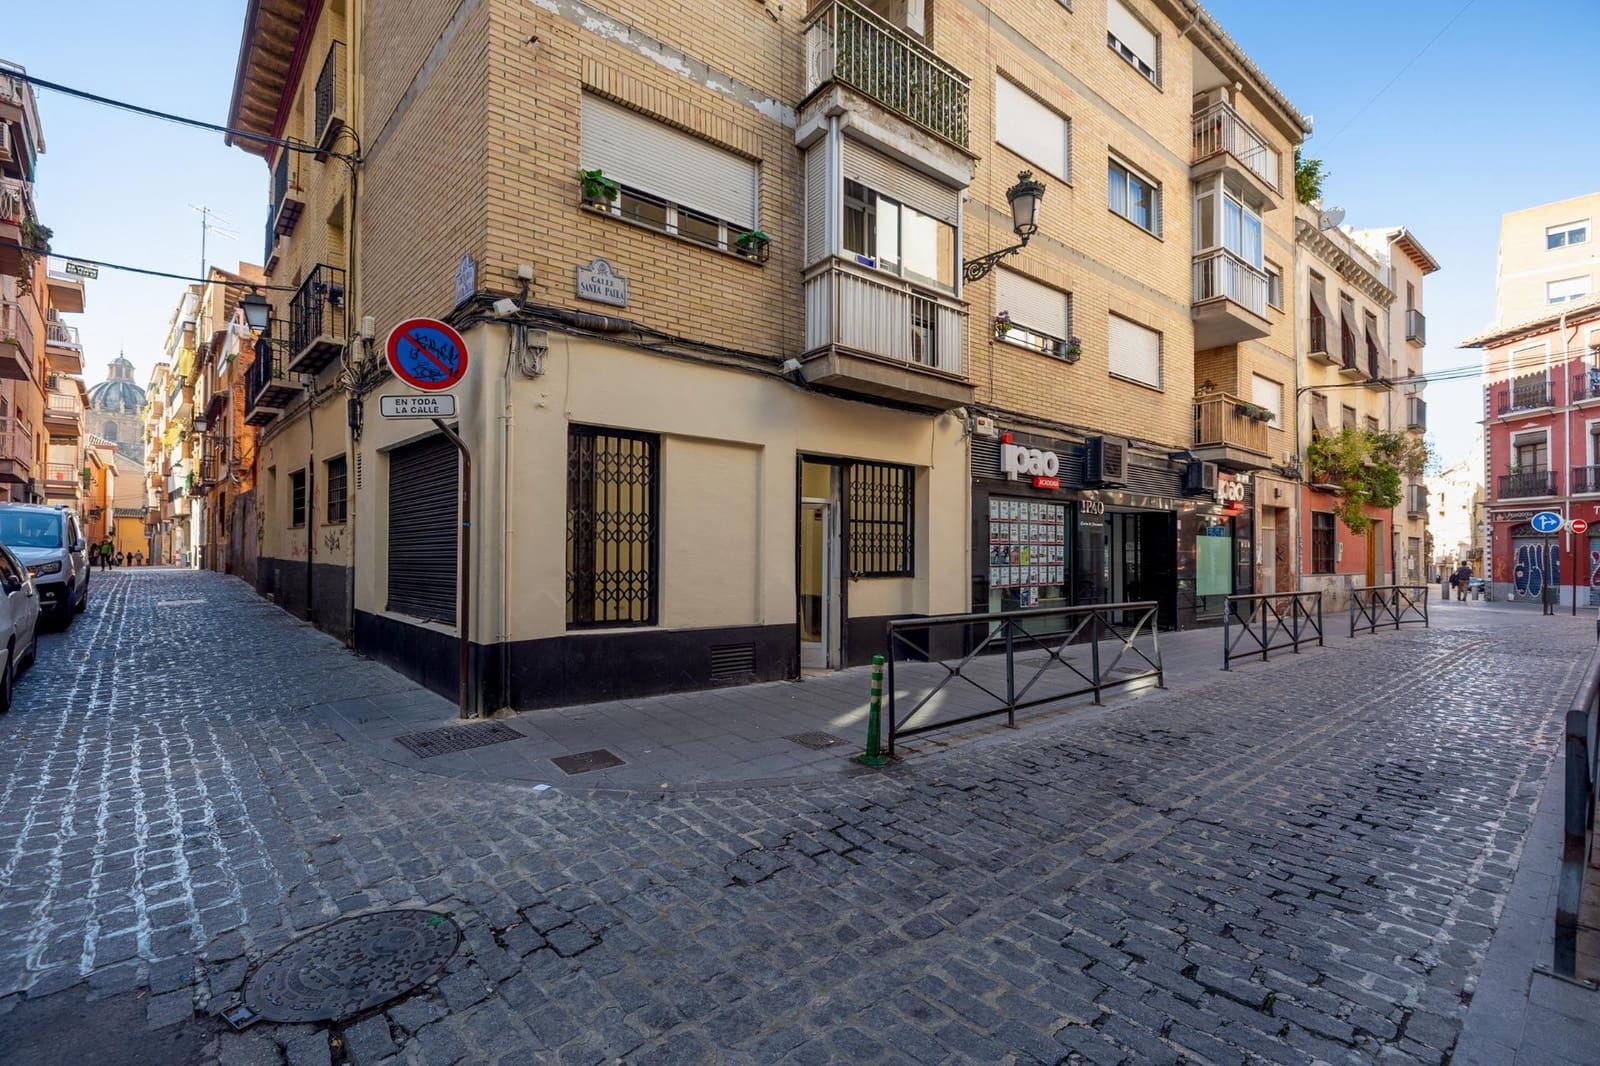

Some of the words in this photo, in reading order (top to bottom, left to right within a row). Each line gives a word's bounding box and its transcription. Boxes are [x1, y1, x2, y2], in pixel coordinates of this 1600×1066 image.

[591, 276, 613, 287] CALLE
[580, 282, 602, 295] SANTA
[605, 287, 624, 300] PAULA
[395, 398, 408, 406] EN
[411, 398, 437, 406] TODA
[395, 406, 408, 414] LA
[410, 406, 440, 414] CALLE
[1081, 500, 1105, 515] IPAO
